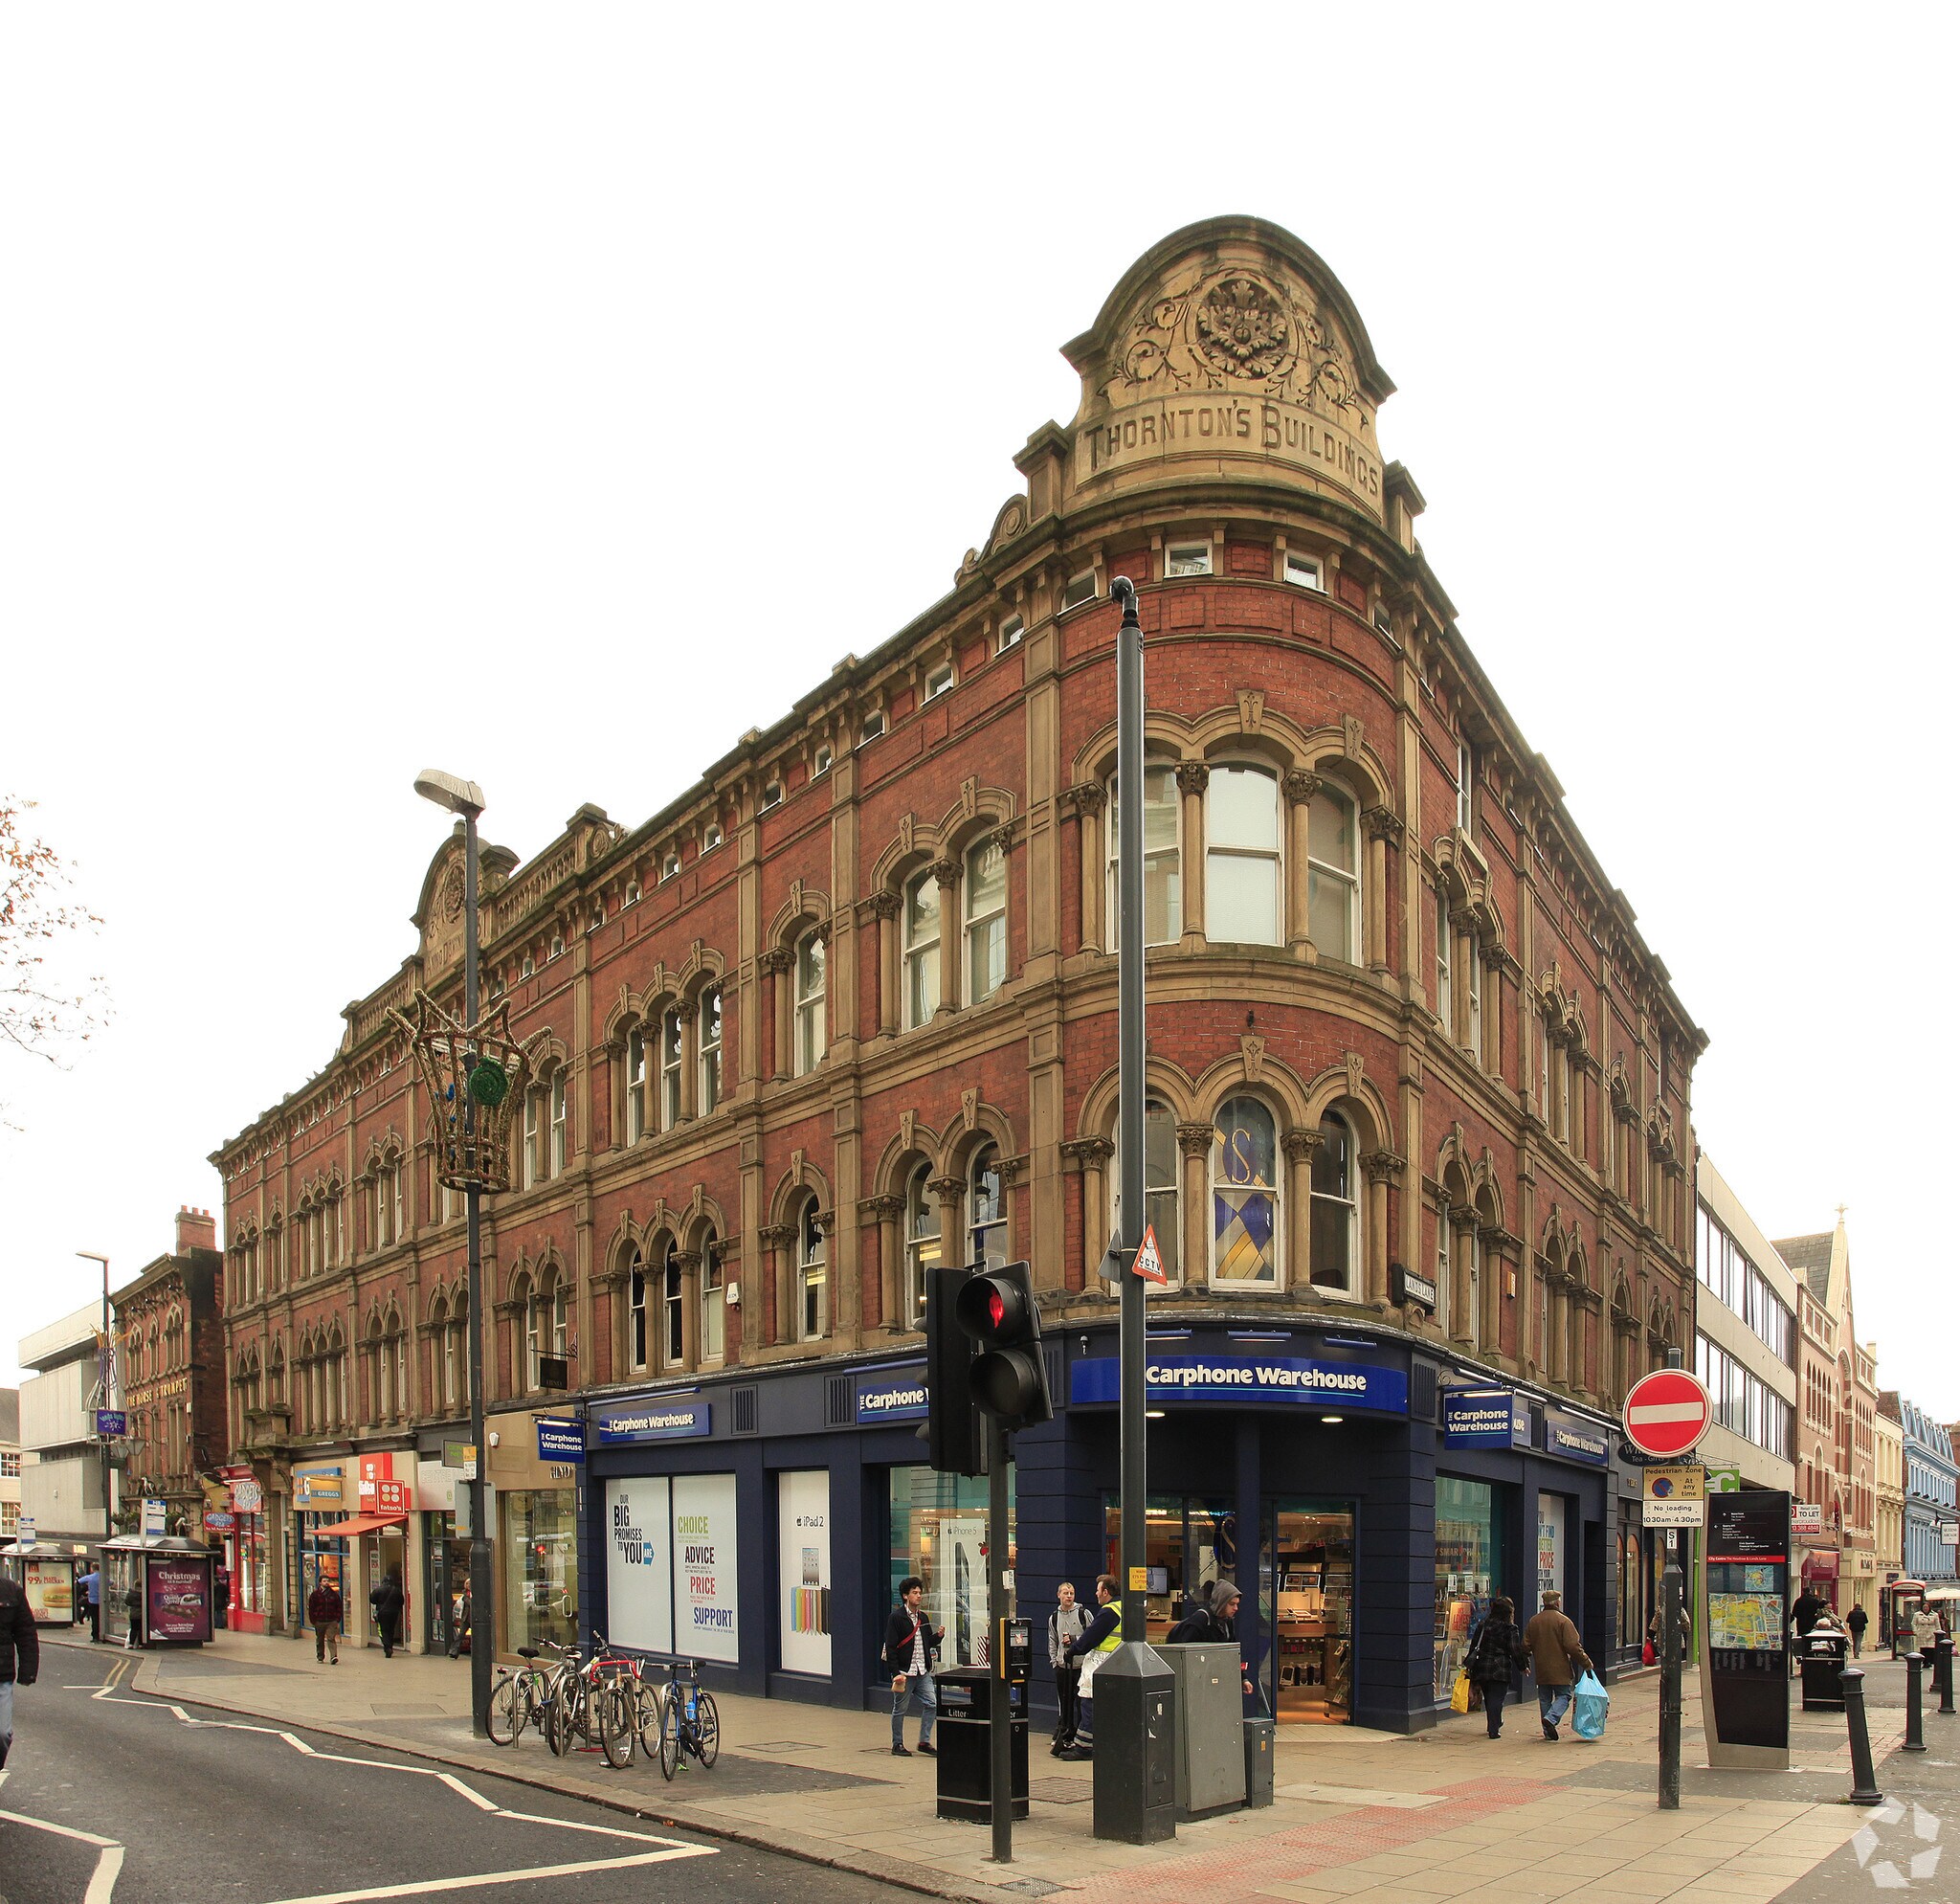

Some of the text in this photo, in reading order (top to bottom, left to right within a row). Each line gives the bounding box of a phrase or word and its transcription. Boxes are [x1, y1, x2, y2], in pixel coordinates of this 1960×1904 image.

[1084, 399, 1380, 497] THORNTON'S BUILDINGS
[1140, 1255, 1161, 1271] CCTV
[1146, 1364, 1368, 1391] Carphone Warehouse
[865, 1389, 924, 1410] Carphone
[612, 1417, 649, 1433] Carphone
[649, 1413, 694, 1428] Warehouse
[1454, 1410, 1509, 1422] Carphone
[1449, 1422, 1509, 1432] Warehouse
[542, 1441, 583, 1451] Warehouse
[545, 1433, 582, 1444] Carphone
[1559, 1430, 1581, 1447] Carphone
[1580, 1438, 1604, 1455] Warehouse
[619, 1494, 630, 1505] OUR
[613, 1505, 630, 1527] BIG
[678, 1515, 709, 1534] CHOICE
[613, 1528, 643, 1541] PROMISES
[1668, 1531, 1676, 1539] S
[623, 1541, 643, 1565] YOU
[644, 1548, 653, 1558] ARE
[684, 1546, 716, 1564] ADVICE
[1539, 1551, 1554, 1569] PRICE
[159, 1571, 201, 1580] Christmas
[1538, 1578, 1554, 1591] ETWORK
[690, 1576, 716, 1595] PRICE
[693, 1606, 733, 1627] SUPPORT
[947, 1709, 968, 1719] Litter
